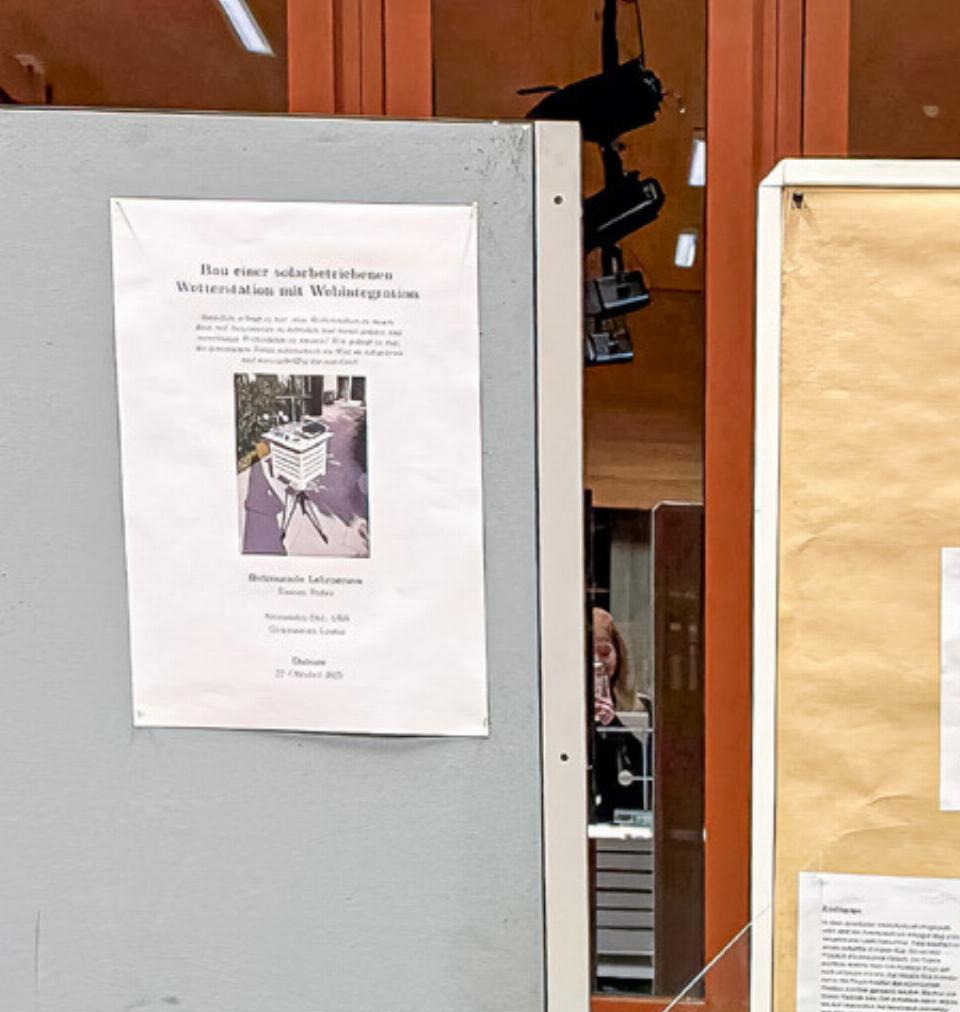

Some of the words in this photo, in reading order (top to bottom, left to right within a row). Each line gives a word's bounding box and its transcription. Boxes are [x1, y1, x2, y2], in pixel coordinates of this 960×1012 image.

[200, 263, 229, 277] Bau
[233, 267, 269, 279] einer
[278, 285, 304, 298] mit
